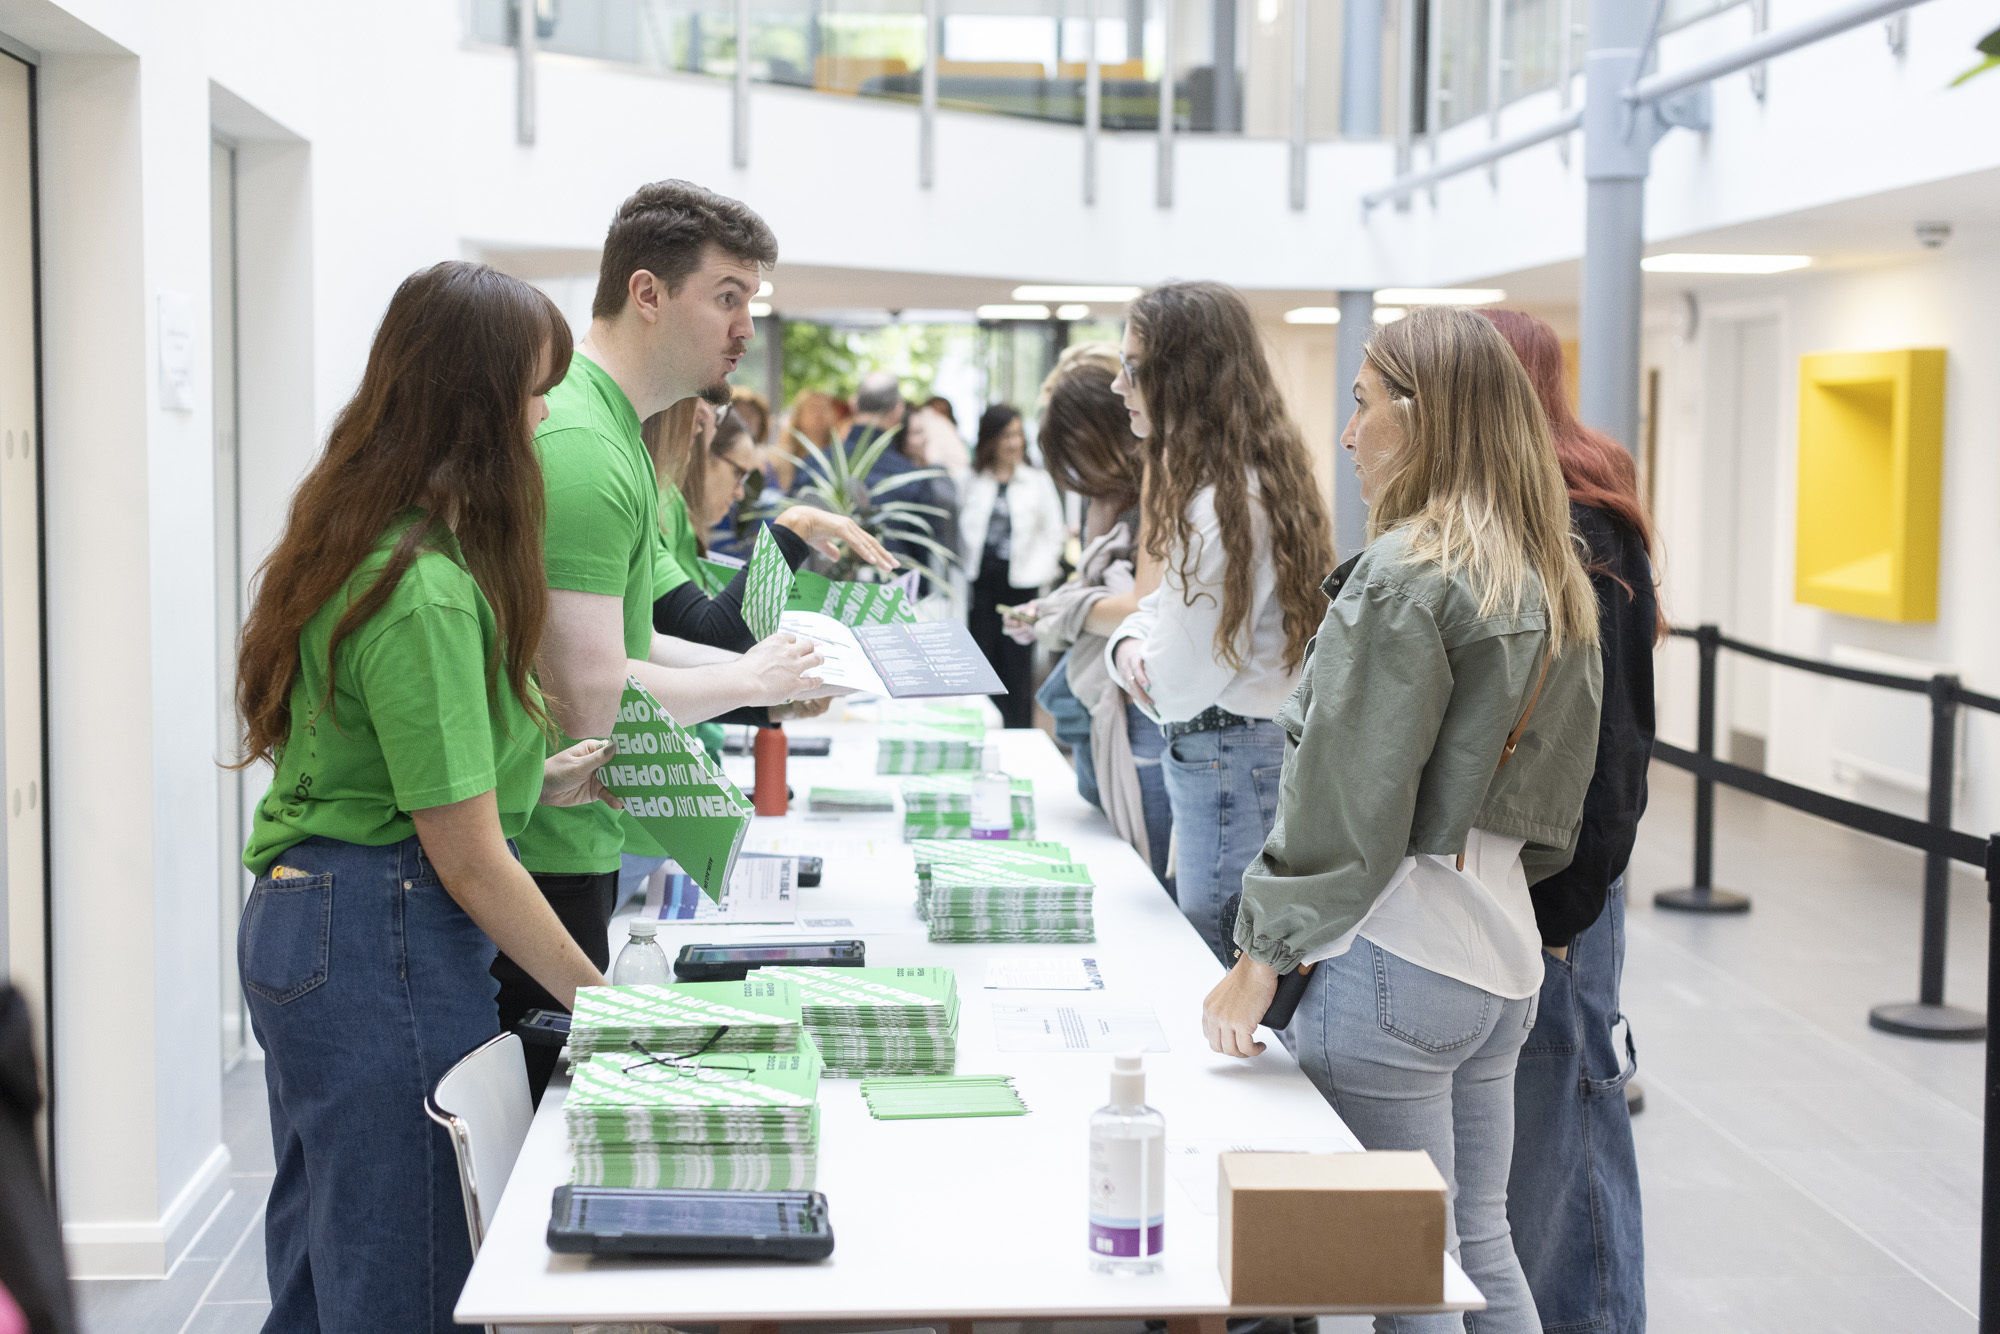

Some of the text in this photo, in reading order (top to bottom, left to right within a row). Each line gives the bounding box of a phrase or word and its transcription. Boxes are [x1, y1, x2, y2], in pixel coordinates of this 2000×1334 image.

[869, 595, 888, 620] DAY
[610, 764, 666, 786] OPEN
[667, 764, 688, 785] DAY
[676, 796, 698, 817] DAY
[862, 983, 942, 1006] OPEN
